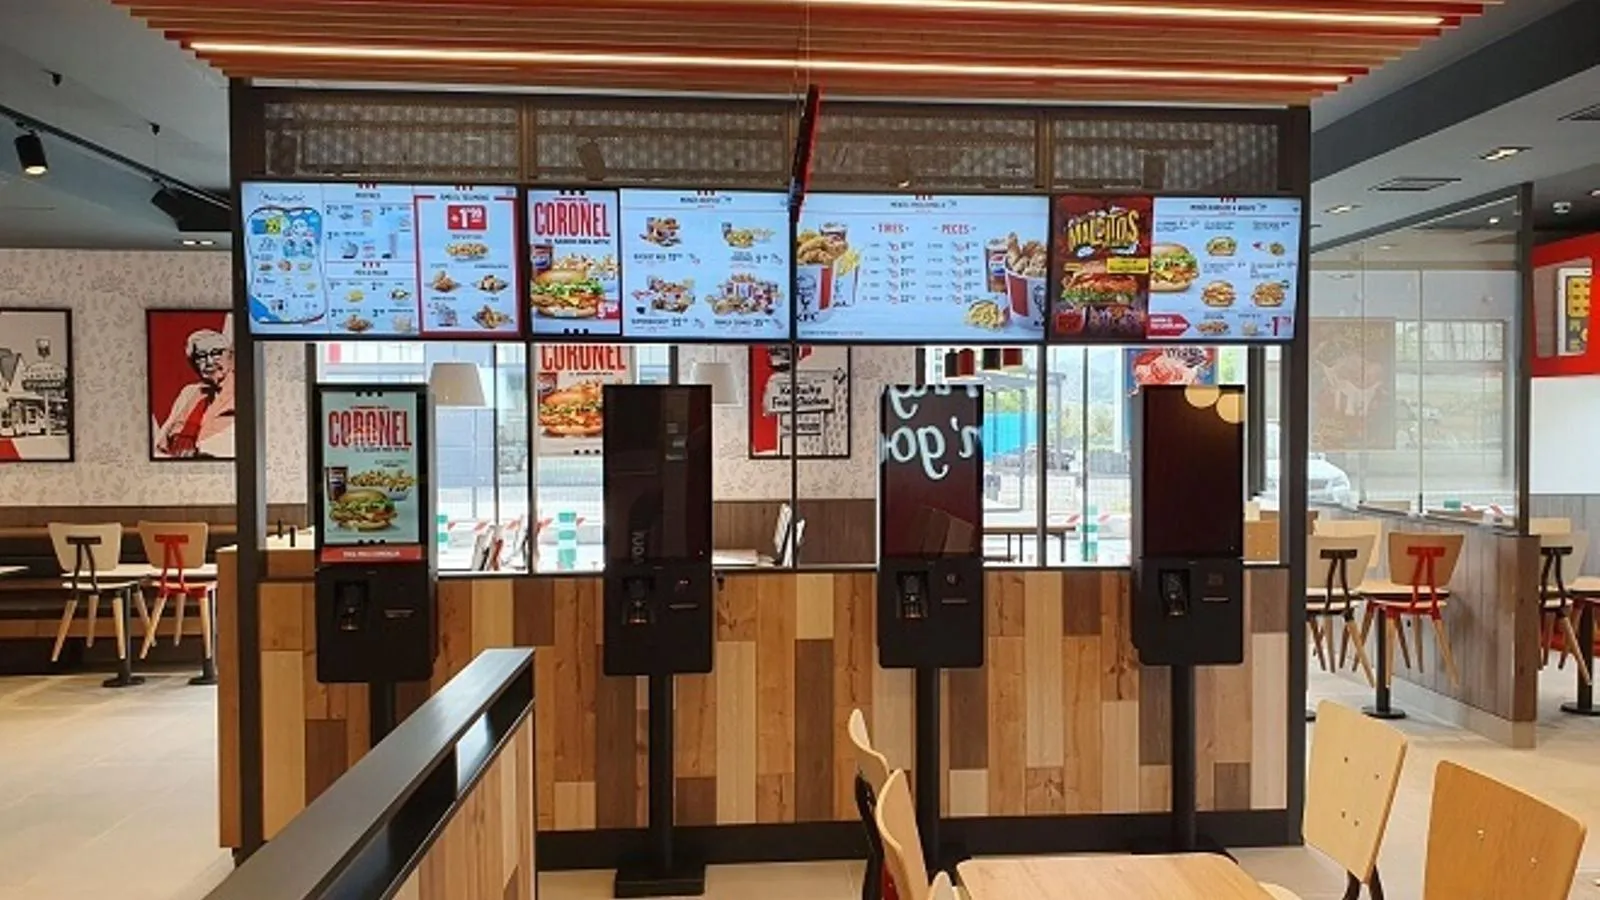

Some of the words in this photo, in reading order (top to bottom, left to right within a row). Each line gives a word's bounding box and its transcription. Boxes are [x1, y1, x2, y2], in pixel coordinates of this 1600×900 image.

[535, 202, 611, 238] CORONEL
[541, 345, 627, 371] CORONEL
[328, 411, 412, 448] CORONEL
